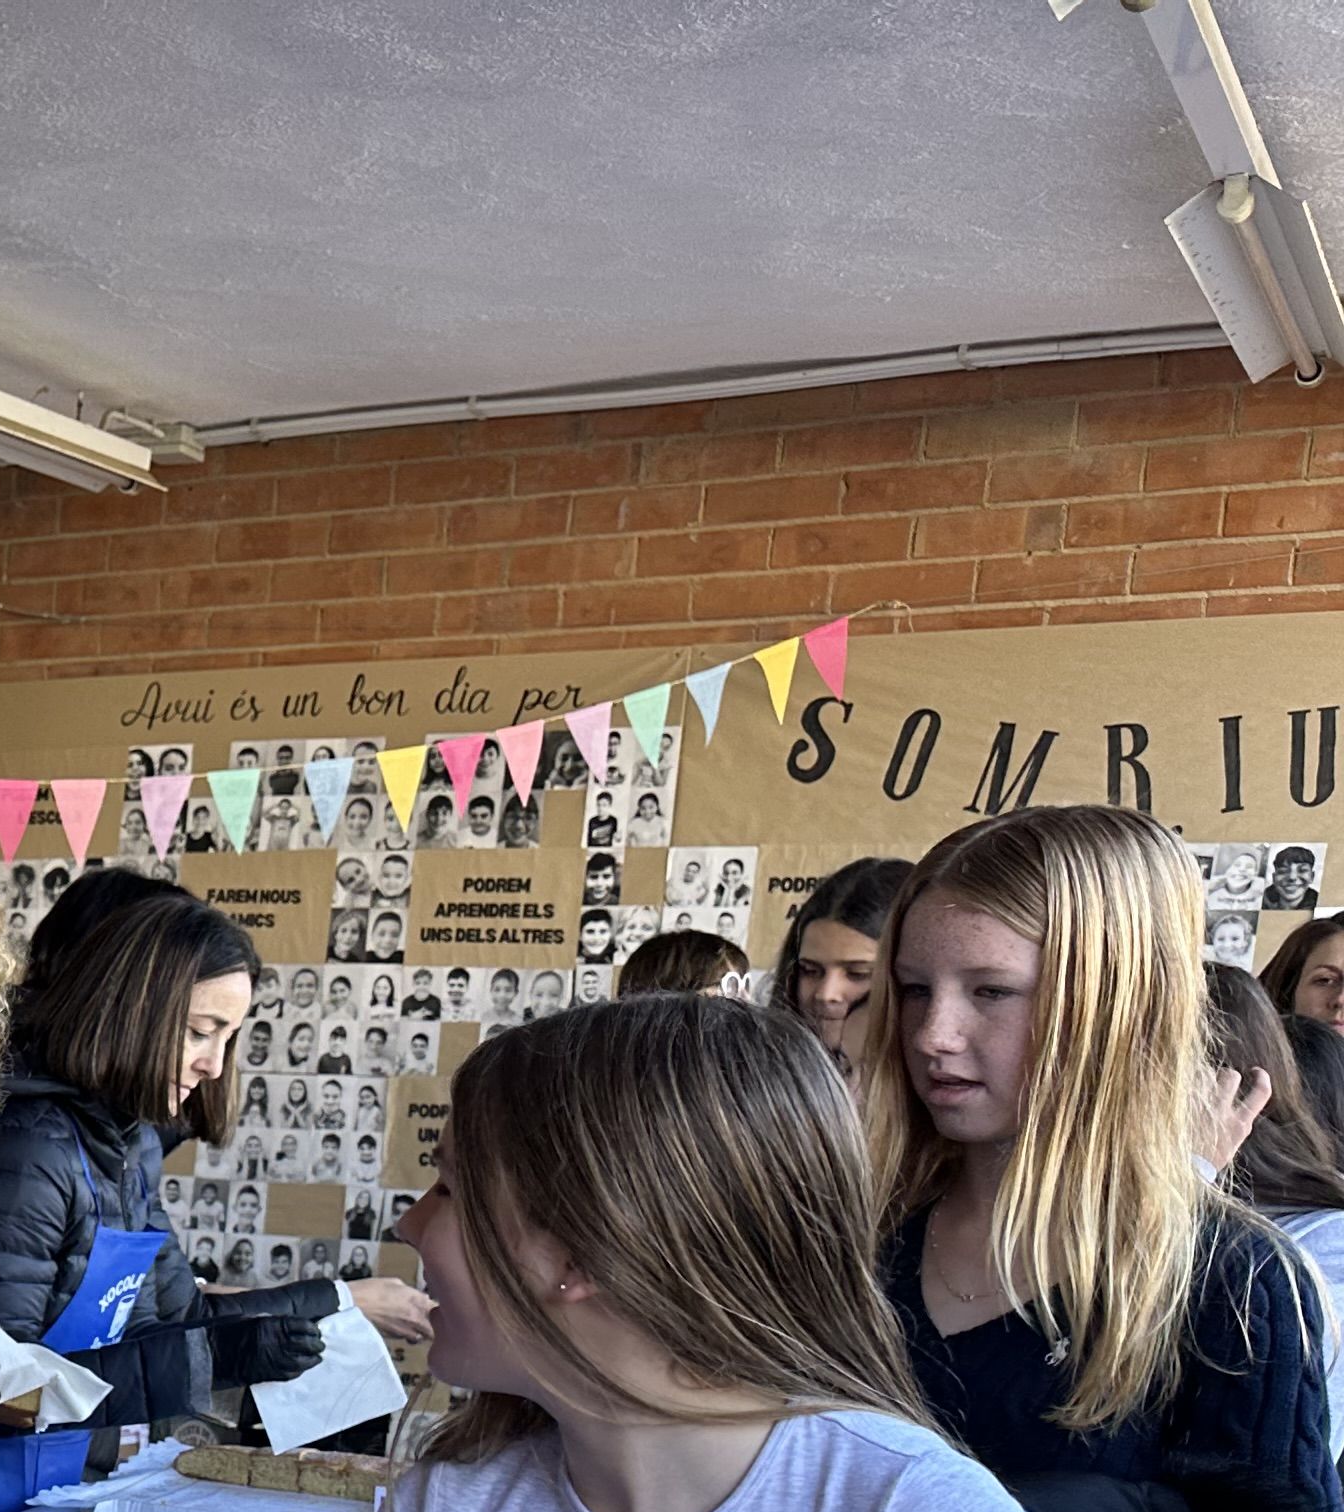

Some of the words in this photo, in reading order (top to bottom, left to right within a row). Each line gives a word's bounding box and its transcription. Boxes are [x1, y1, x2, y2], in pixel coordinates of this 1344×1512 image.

[120, 681, 215, 729] Avui
[230, 690, 264, 722] és
[282, 688, 322, 719] un
[347, 673, 410, 719] bon
[433, 665, 493, 716] dia
[463, 877, 531, 893] PODREM
[207, 889, 258, 904] FAREM
[260, 889, 301, 904] NOUS
[434, 903, 520, 919] APRENDRE
[523, 903, 555, 919] ELS
[420, 927, 453, 943] UNS
[455, 928, 496, 943] DELS
[499, 928, 565, 944] ALTRES
